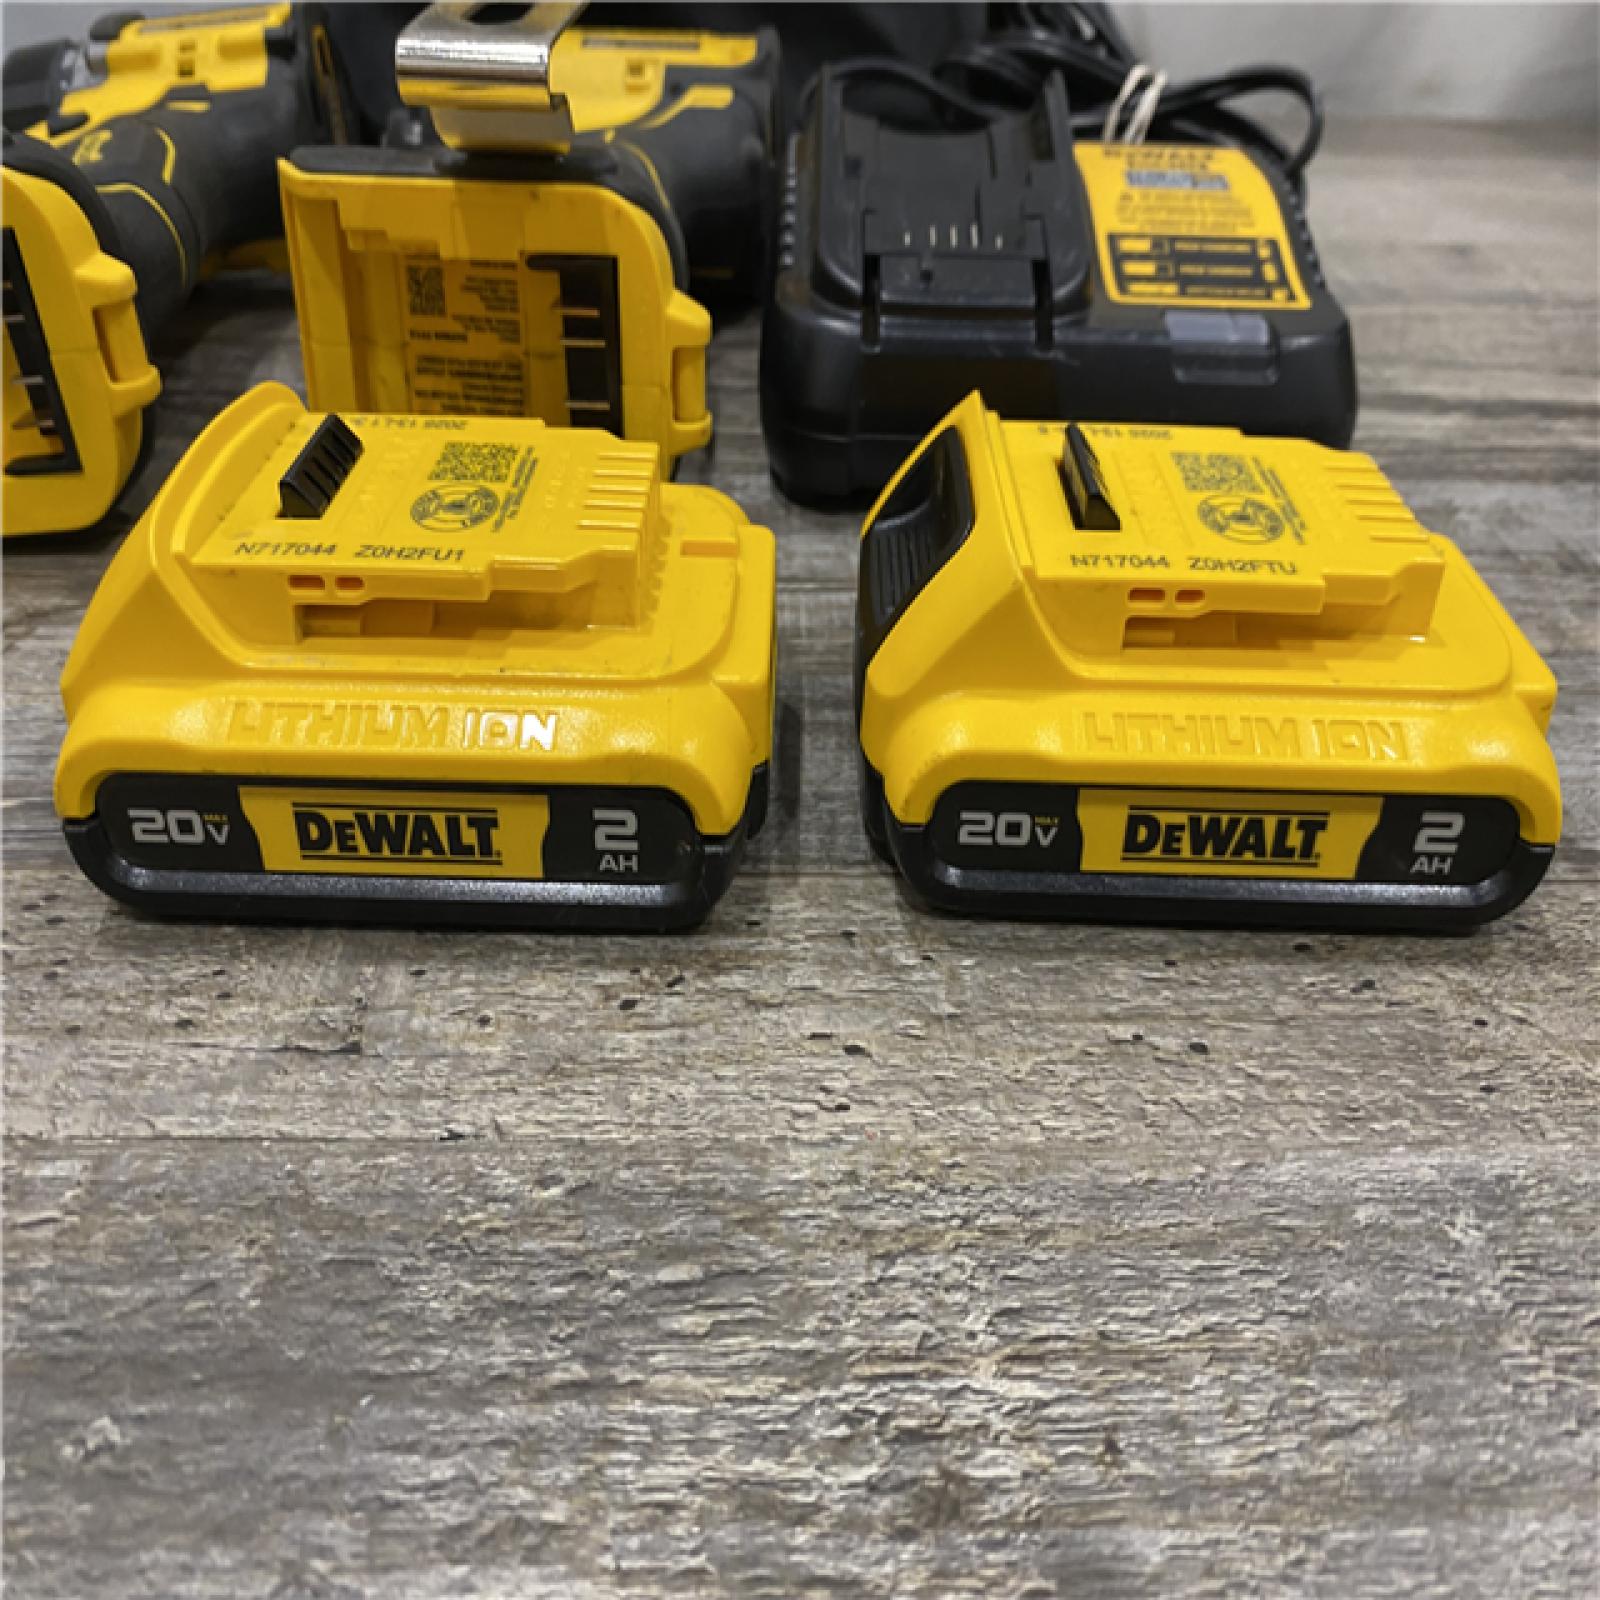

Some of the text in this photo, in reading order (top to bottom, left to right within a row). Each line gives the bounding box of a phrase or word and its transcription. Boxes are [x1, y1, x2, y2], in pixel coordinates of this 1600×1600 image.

[226, 703, 558, 750] LITHIUM ION
[1080, 711, 1408, 760] LITHIUM ION
[592, 808, 640, 850] 2
[1415, 811, 1465, 854] 2
[600, 854, 638, 872] AH
[1410, 856, 1452, 874] AH
